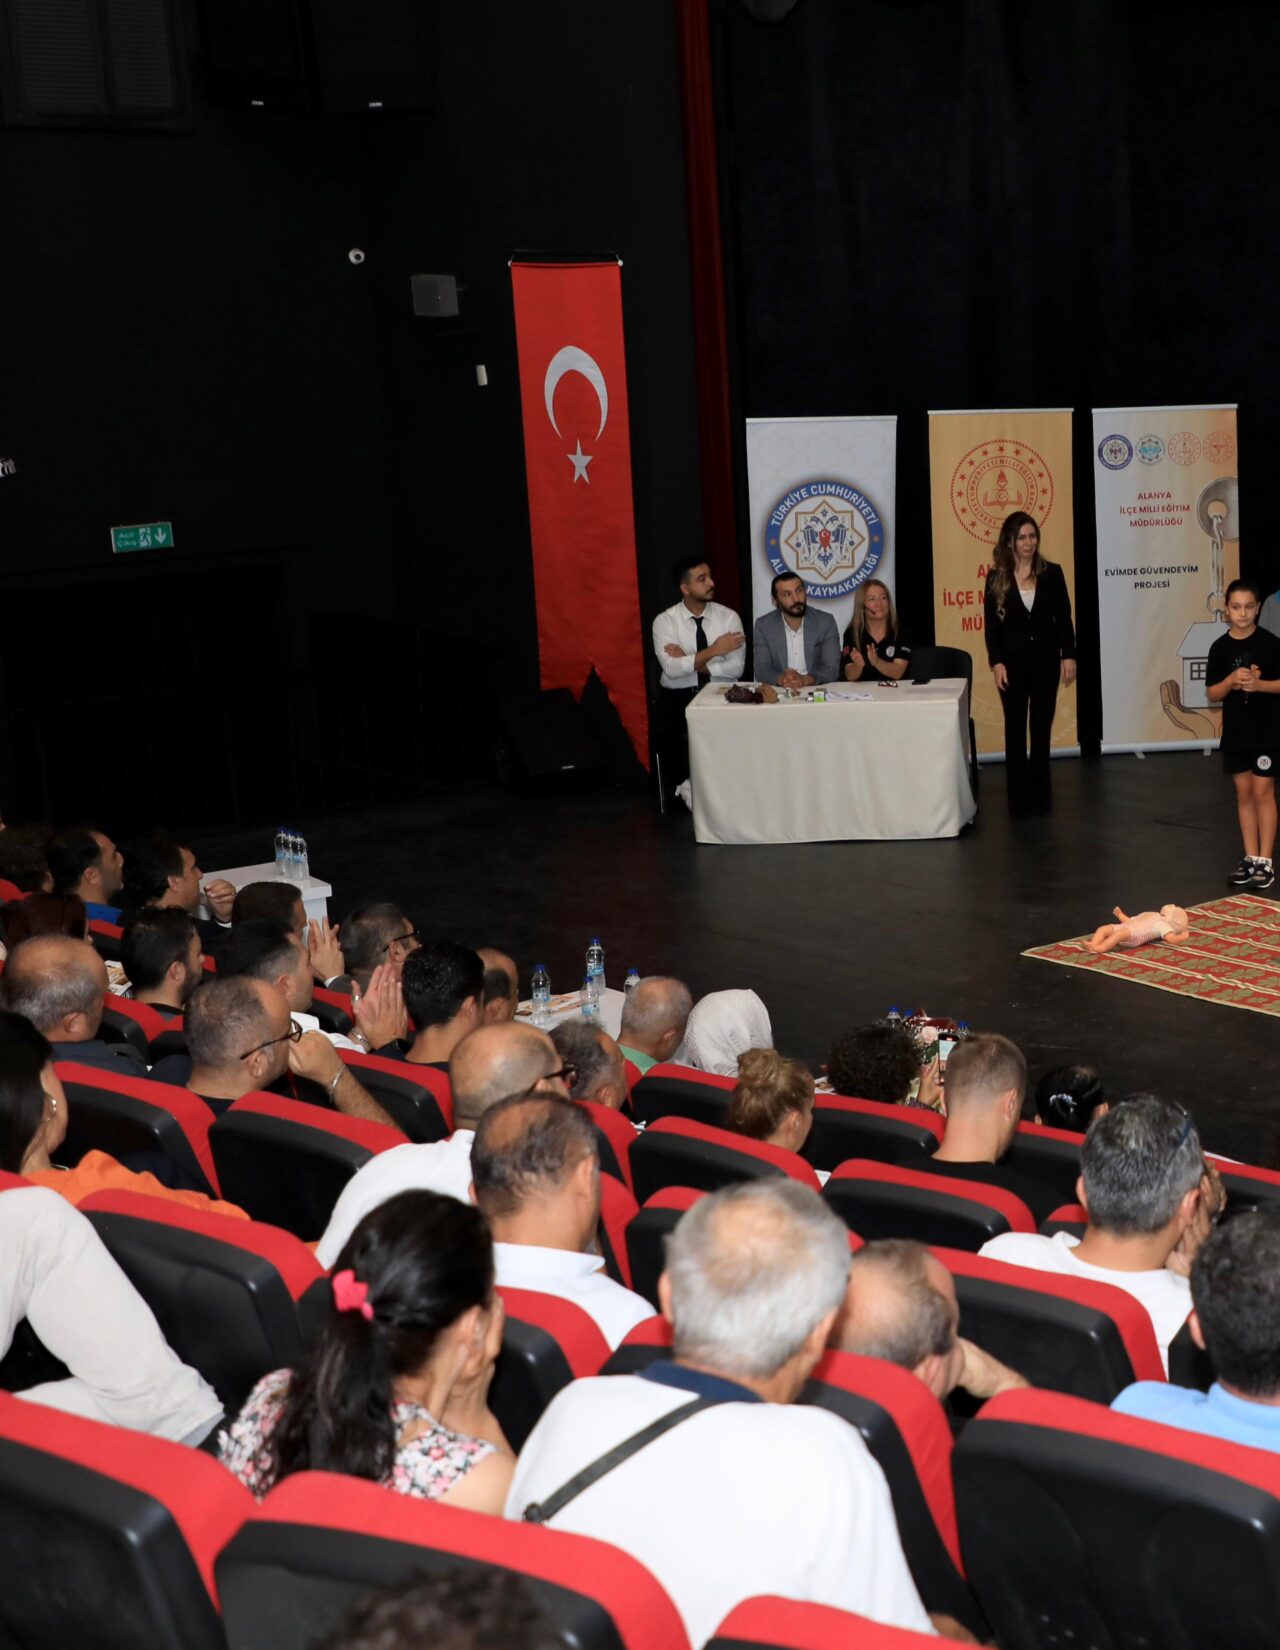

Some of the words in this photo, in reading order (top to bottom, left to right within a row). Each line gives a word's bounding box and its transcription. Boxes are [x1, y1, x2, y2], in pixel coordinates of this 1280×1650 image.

[1137, 491, 1172, 501] ALANYA
[771, 487, 810, 526] TÜRKİYE
[810, 484, 880, 525] CUMHURİYETİ
[1119, 503, 1138, 516] İLÇE
[806, 553, 880, 597] KAYMAKAMLIĞI
[1104, 566, 1139, 577] EVİMDE
[1139, 564, 1199, 576] GÜVENDEYİM
[1134, 580, 1170, 590] PROJESİ
[943, 588, 974, 610] İLÇE
